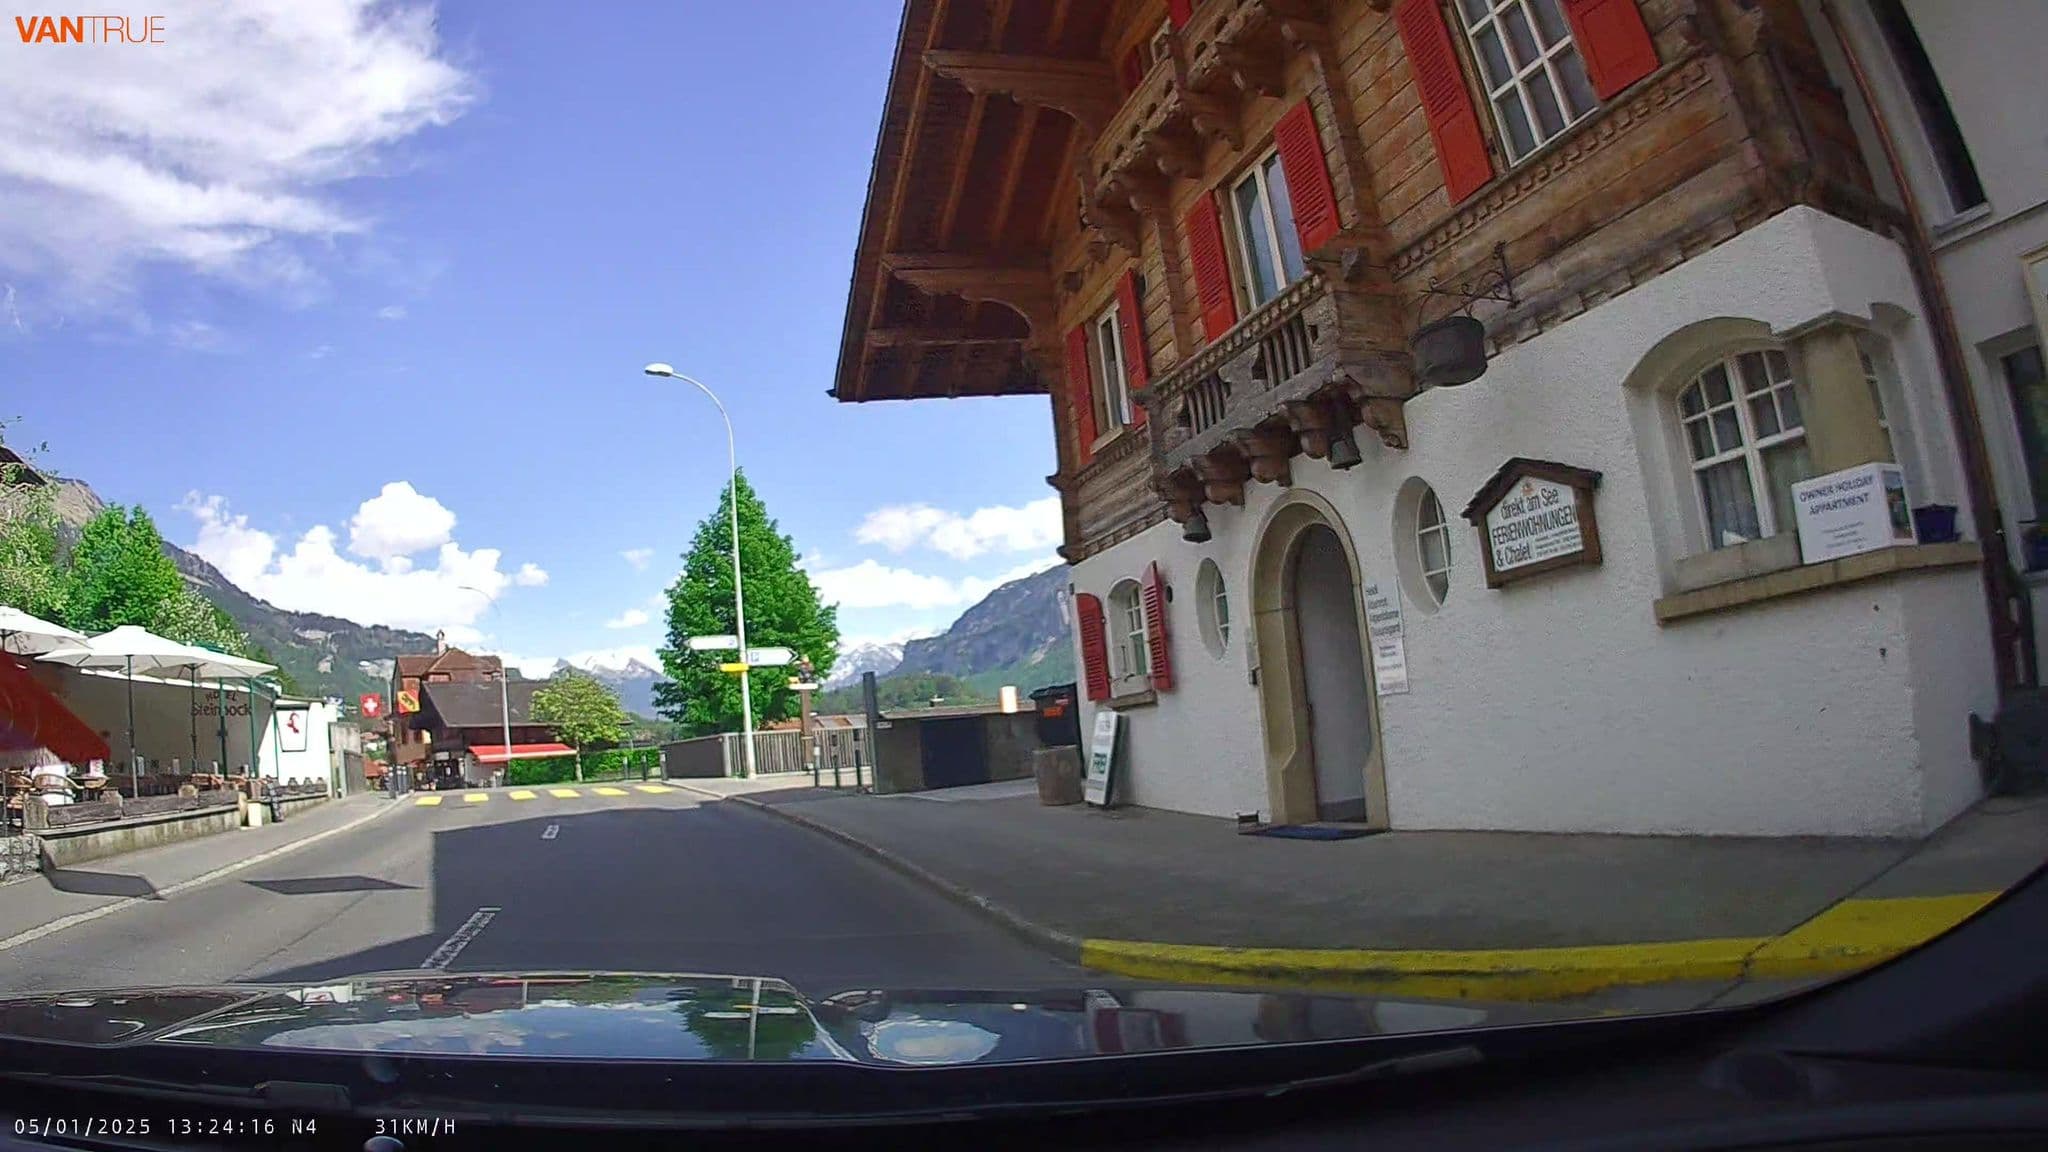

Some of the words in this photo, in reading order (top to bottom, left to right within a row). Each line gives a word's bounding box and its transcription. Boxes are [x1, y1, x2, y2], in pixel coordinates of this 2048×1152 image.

[1836, 475, 1874, 492] HOLIDAY
[1501, 497, 1525, 520] direkt
[1526, 495, 1541, 511] am
[1541, 488, 1560, 506] See
[1491, 503, 1577, 546] FERIENWOHNUNGEN
[1495, 549, 1504, 567] &
[1504, 542, 1532, 564] Chalet
[205, 691, 237, 702] HOEL
